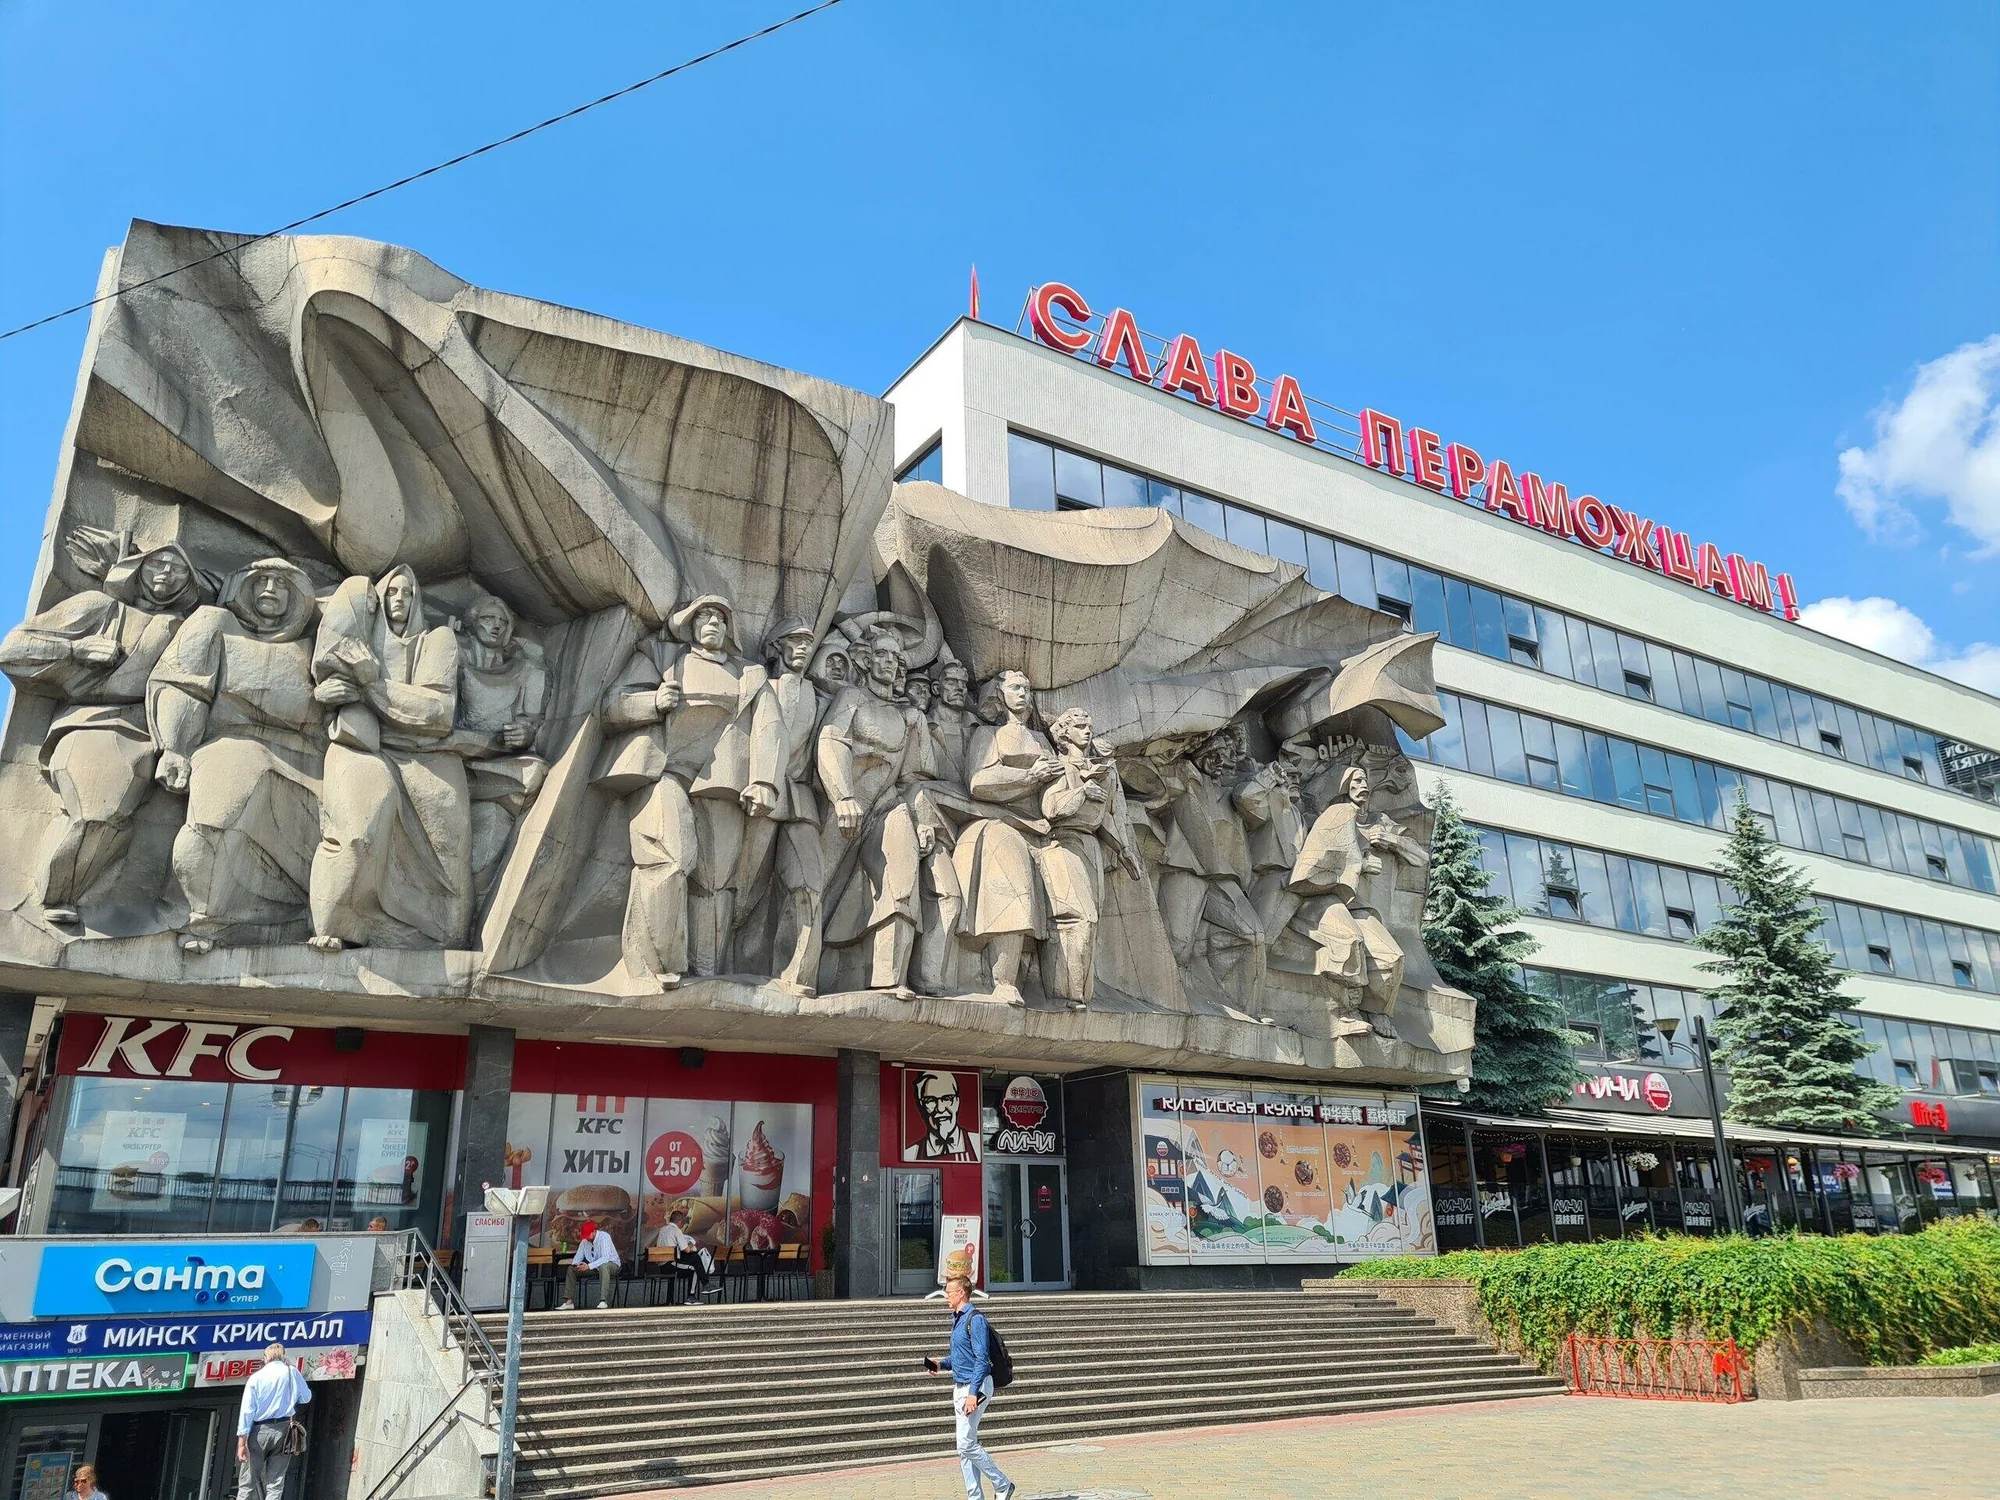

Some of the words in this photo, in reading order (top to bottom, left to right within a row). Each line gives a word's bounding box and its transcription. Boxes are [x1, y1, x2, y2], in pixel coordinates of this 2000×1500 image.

[1029, 281, 1317, 444] СЛАВА
[1359, 407, 1800, 621] ПЕРАМОЖЦАМ!
[76, 1016, 295, 1081] KFC
[1008, 1104, 1043, 1114] БИСТРО
[1320, 1103, 1363, 1124] 中华美食
[1366, 1107, 1407, 1125] 荔枝餐厅
[575, 1117, 623, 1134] KFC
[127, 1127, 161, 1138] KFC
[122, 1142, 162, 1151] ЧИЗБУРГЕР
[382, 1143, 406, 1151] ЧИКЕН
[669, 1141, 682, 1152] ОТ
[998, 1129, 1056, 1154] ЛИЧИ
[381, 1150, 405, 1158] БУРГЕР
[562, 1149, 630, 1174] ХИТЫ
[475, 1217, 505, 1227] СПАСИБО
[1436, 1213, 1474, 1226] 荔枝餐厅
[1554, 1214, 1585, 1226] 荔枝餐厅
[95, 1257, 265, 1293] Санта
[230, 1294, 260, 1303] СУПЕР
[103, 1325, 200, 1348] МИНСК
[212, 1319, 344, 1344] КРИСТАЛЛ
[204, 1356, 304, 1383] ЦВЕ
